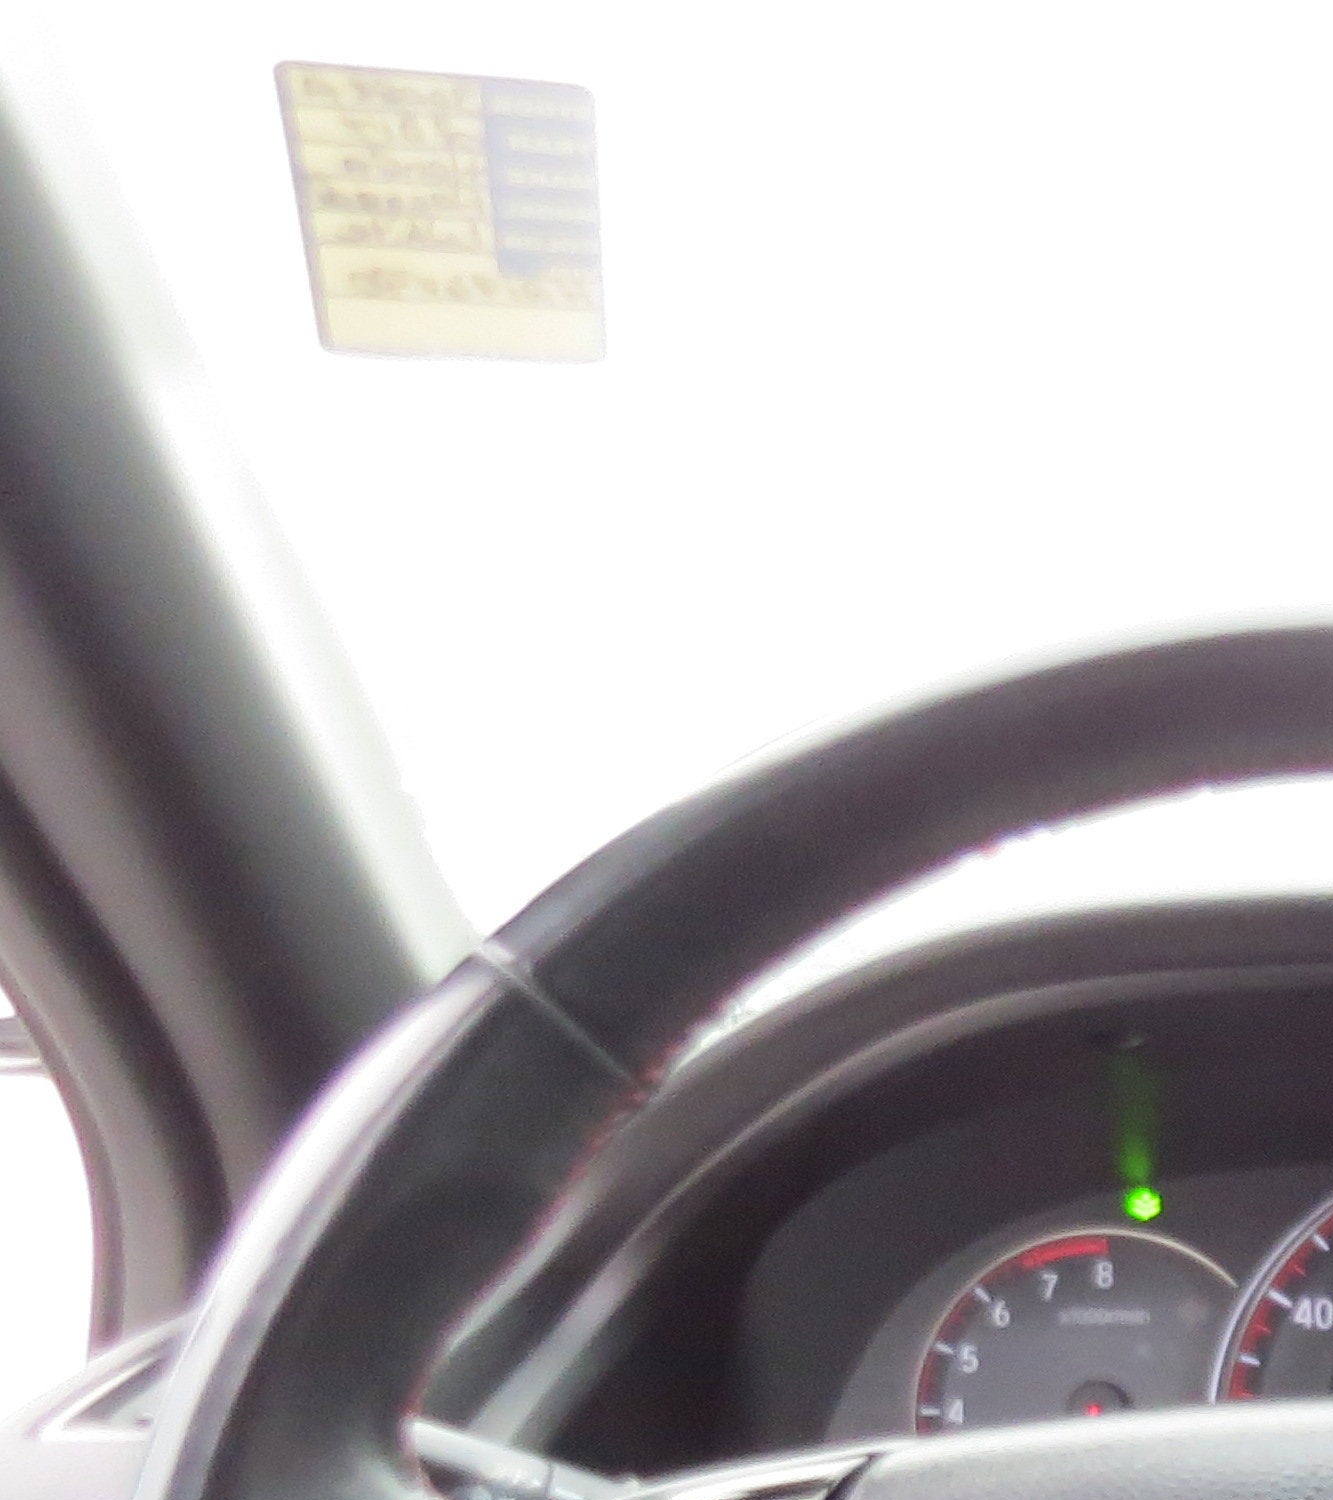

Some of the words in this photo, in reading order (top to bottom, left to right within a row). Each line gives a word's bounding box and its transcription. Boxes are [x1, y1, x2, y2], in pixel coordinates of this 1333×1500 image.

[1037, 1269, 1059, 1302] 7
[1091, 1259, 1115, 1290] 8
[989, 1299, 1011, 1329] 6
[956, 1341, 981, 1374] 5
